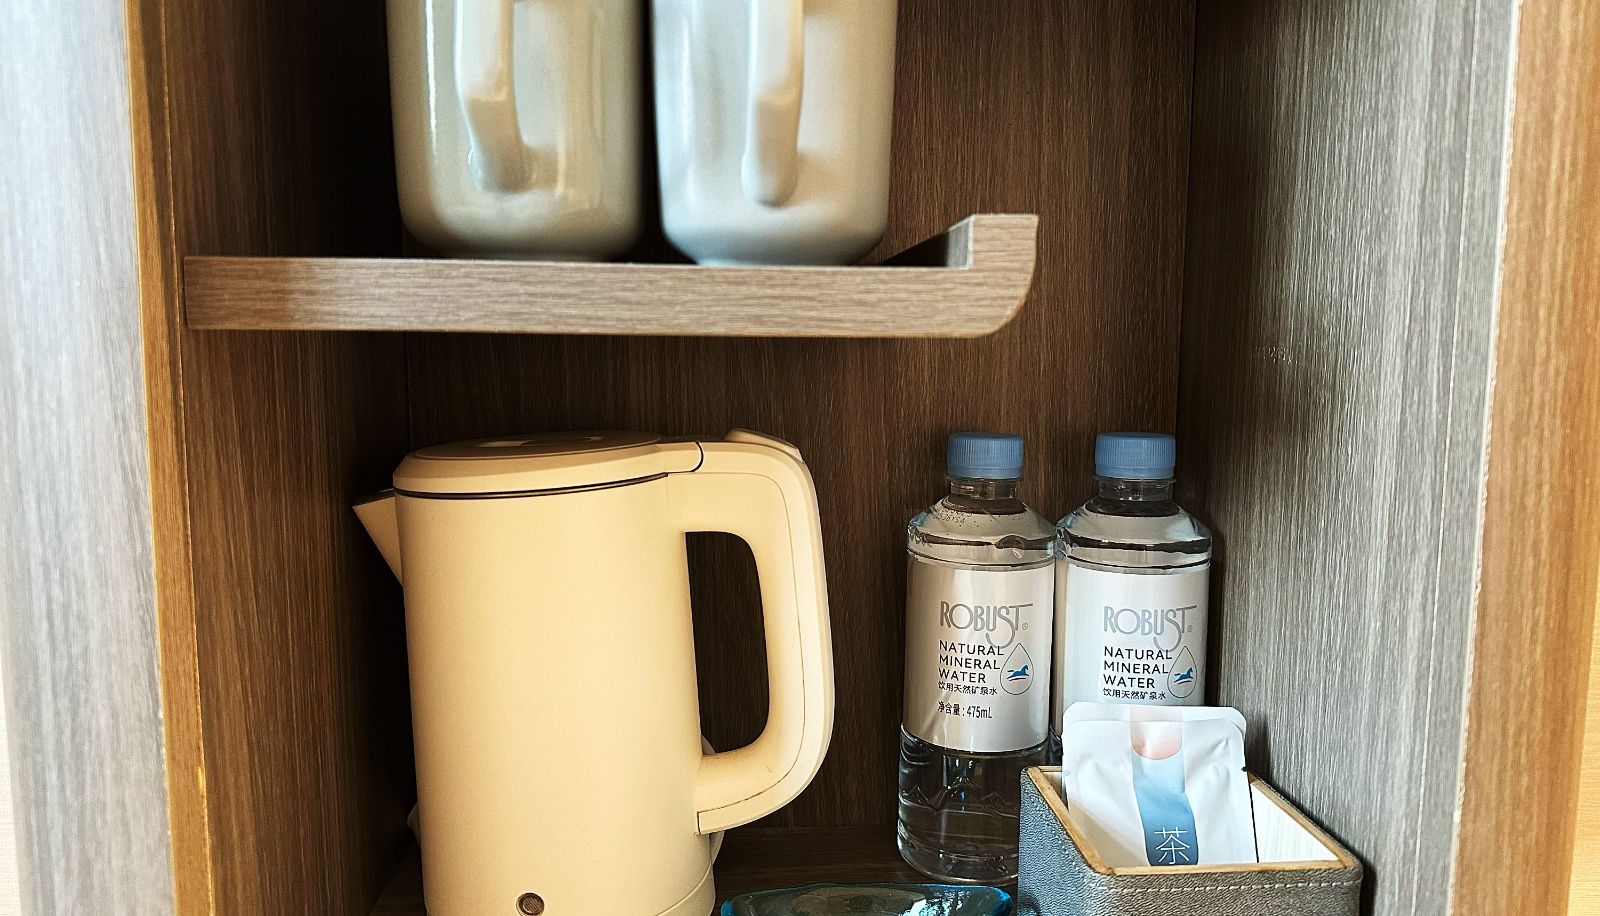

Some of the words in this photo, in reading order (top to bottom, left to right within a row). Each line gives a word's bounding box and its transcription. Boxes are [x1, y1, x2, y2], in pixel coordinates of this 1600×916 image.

[940, 601, 1033, 649] ROBUST
[1104, 605, 1197, 652] ROBUST
[939, 639, 1005, 656] NATURAL
[1104, 645, 1173, 660] NATURAL
[939, 654, 1001, 670] MINERAL
[1103, 659, 1169, 674] MINERAL
[938, 667, 986, 684] WATER
[1103, 673, 1156, 689] WATER
[937, 680, 998, 696] 饮用天然矿泉水
[1103, 687, 1167, 700] 饮用天然矿泉水
[1154, 826, 1190, 866] 茶
